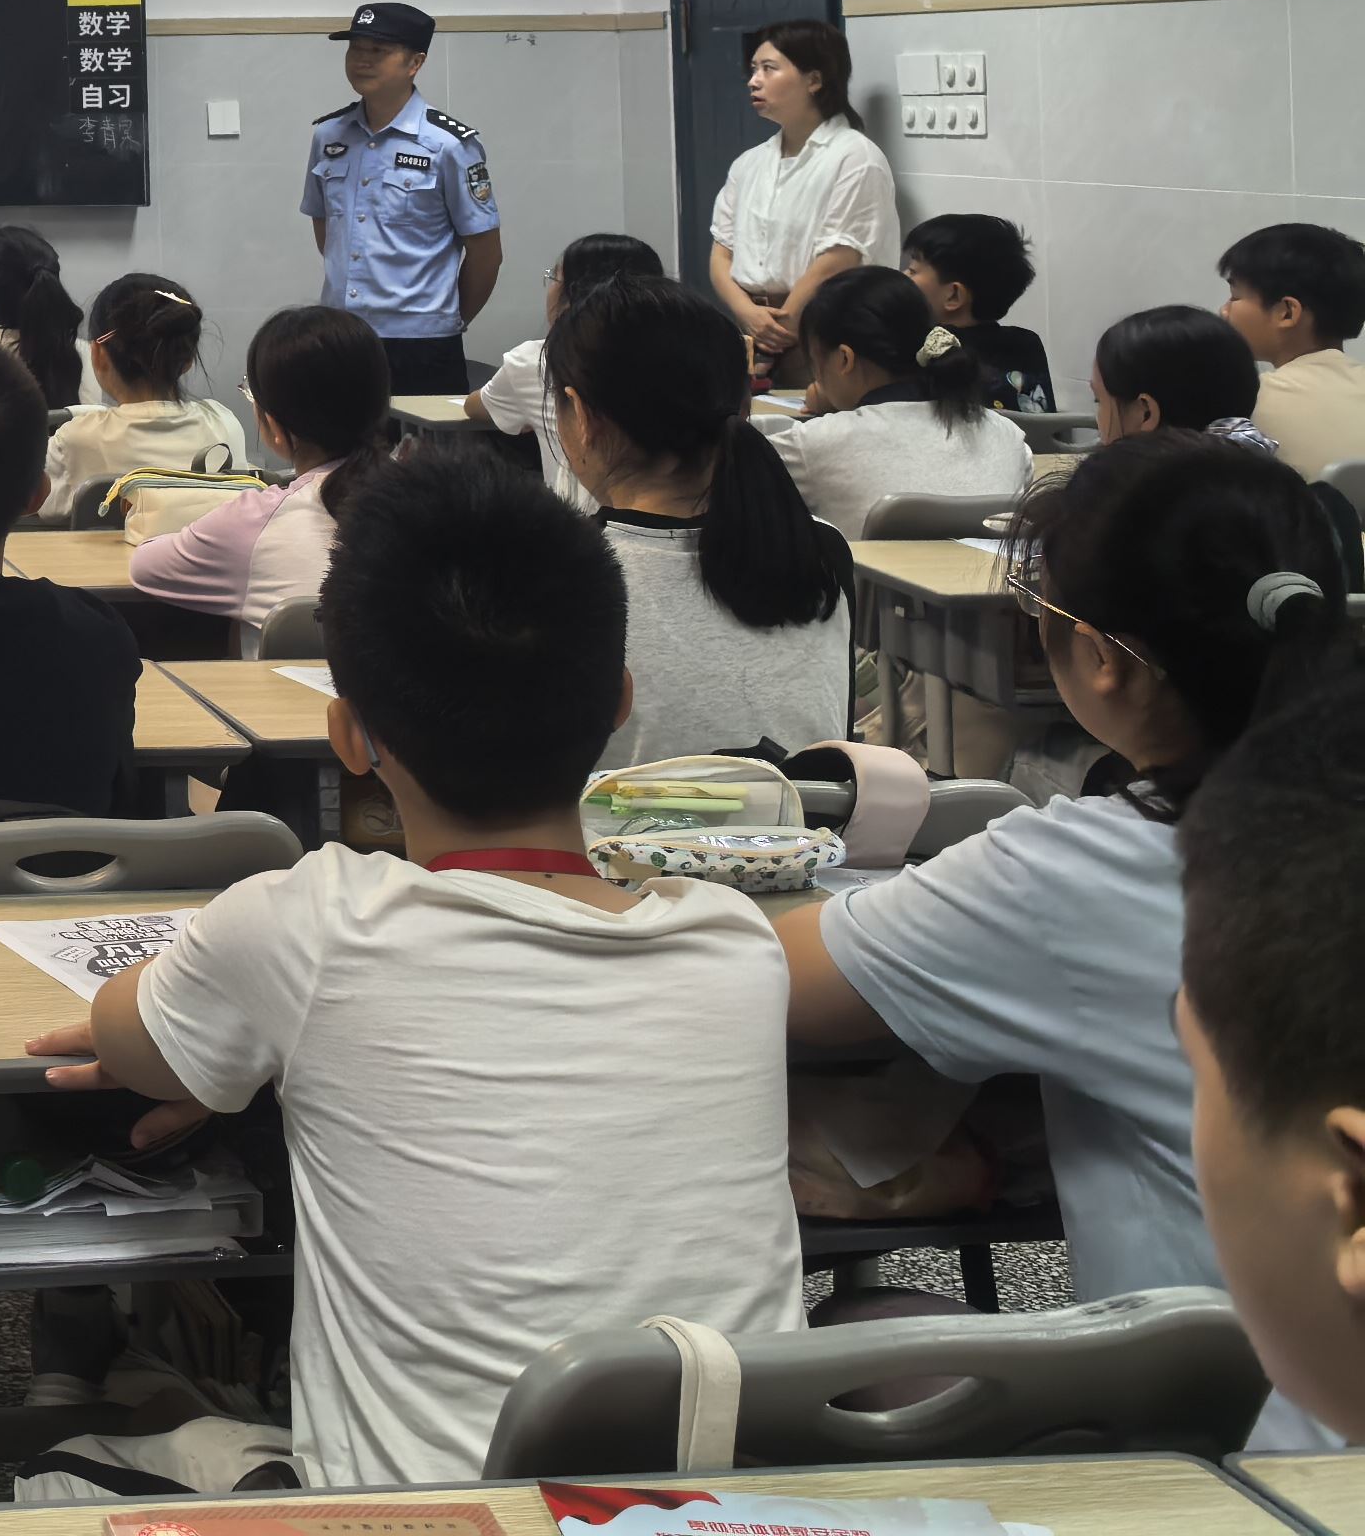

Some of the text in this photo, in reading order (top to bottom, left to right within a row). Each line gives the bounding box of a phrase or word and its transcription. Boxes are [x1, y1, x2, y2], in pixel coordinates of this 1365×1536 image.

[78, 11, 131, 37] 数学
[79, 47, 132, 73] 数学
[81, 83, 131, 109] 自习
